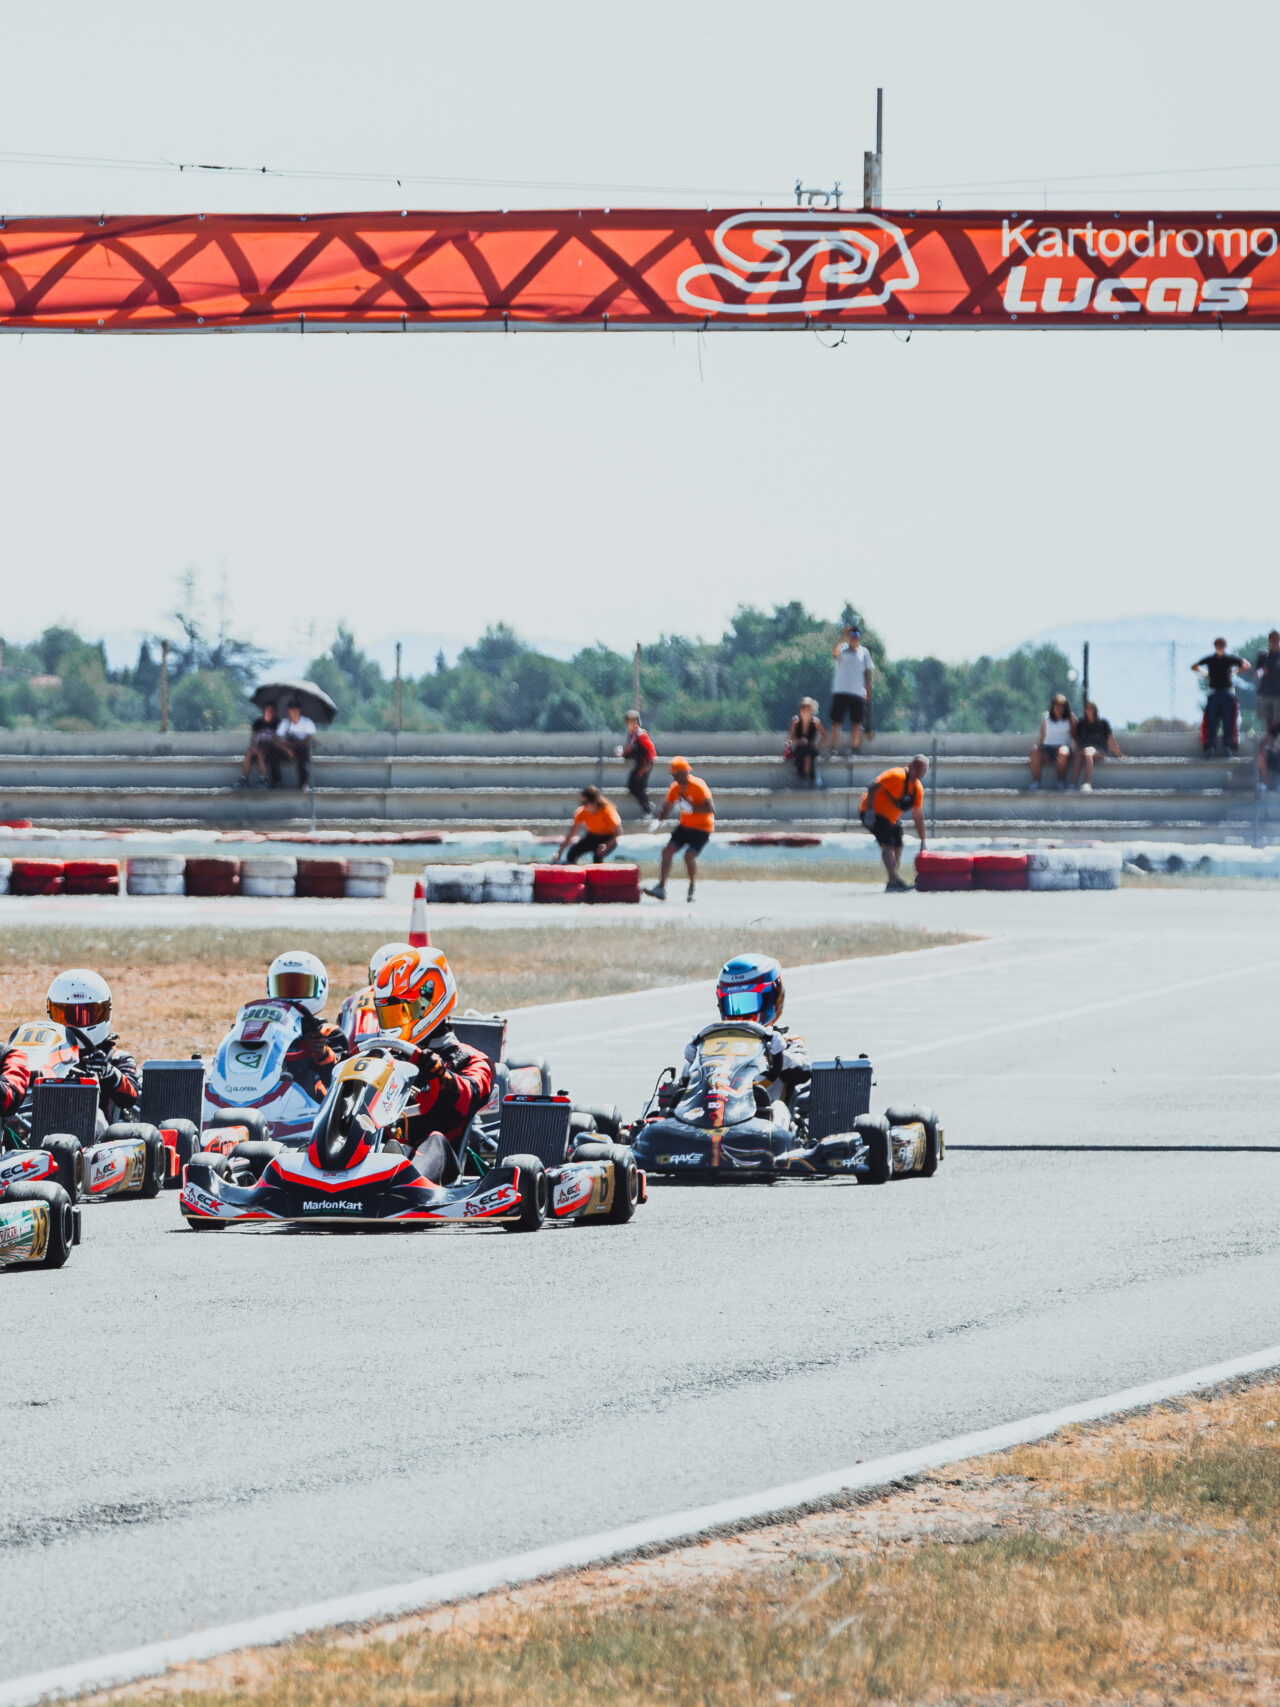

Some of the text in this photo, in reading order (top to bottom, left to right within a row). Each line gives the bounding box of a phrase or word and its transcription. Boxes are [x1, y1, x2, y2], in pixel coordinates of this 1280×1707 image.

[1002, 218, 1278, 257] Kartodromo
[1003, 265, 1253, 313] Lucas
[0, 1157, 39, 1180] ECK
[197, 1193, 225, 1212] ECK
[479, 1186, 511, 1205] ECK
